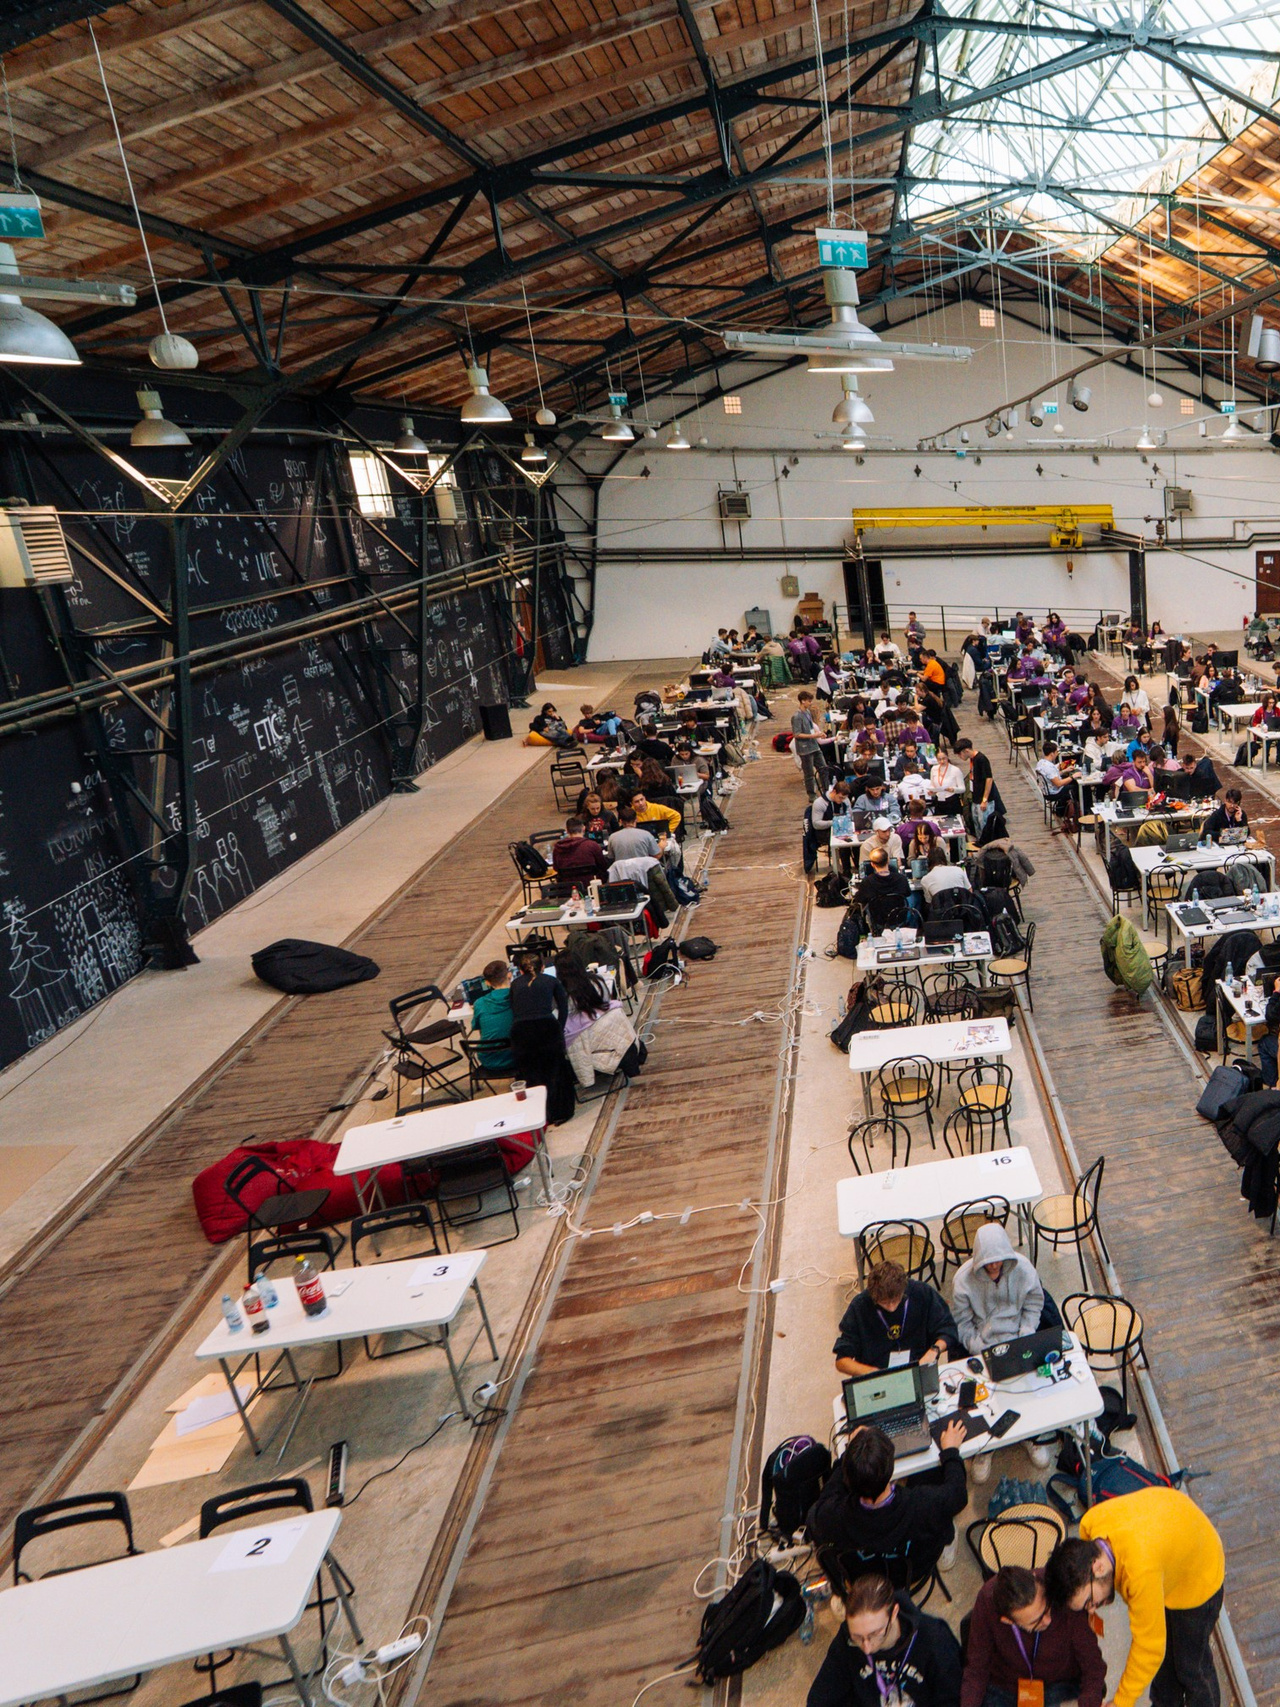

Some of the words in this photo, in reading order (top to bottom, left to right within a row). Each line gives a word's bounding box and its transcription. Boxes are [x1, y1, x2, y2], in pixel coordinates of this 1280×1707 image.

[255, 552, 281, 581] LIKE
[308, 649, 324, 666] ME
[253, 713, 283, 751] ETIC
[493, 1120, 506, 1128] 4
[991, 1155, 1012, 1166] 16
[432, 1265, 450, 1277] 3
[244, 1537, 272, 1558] 2
